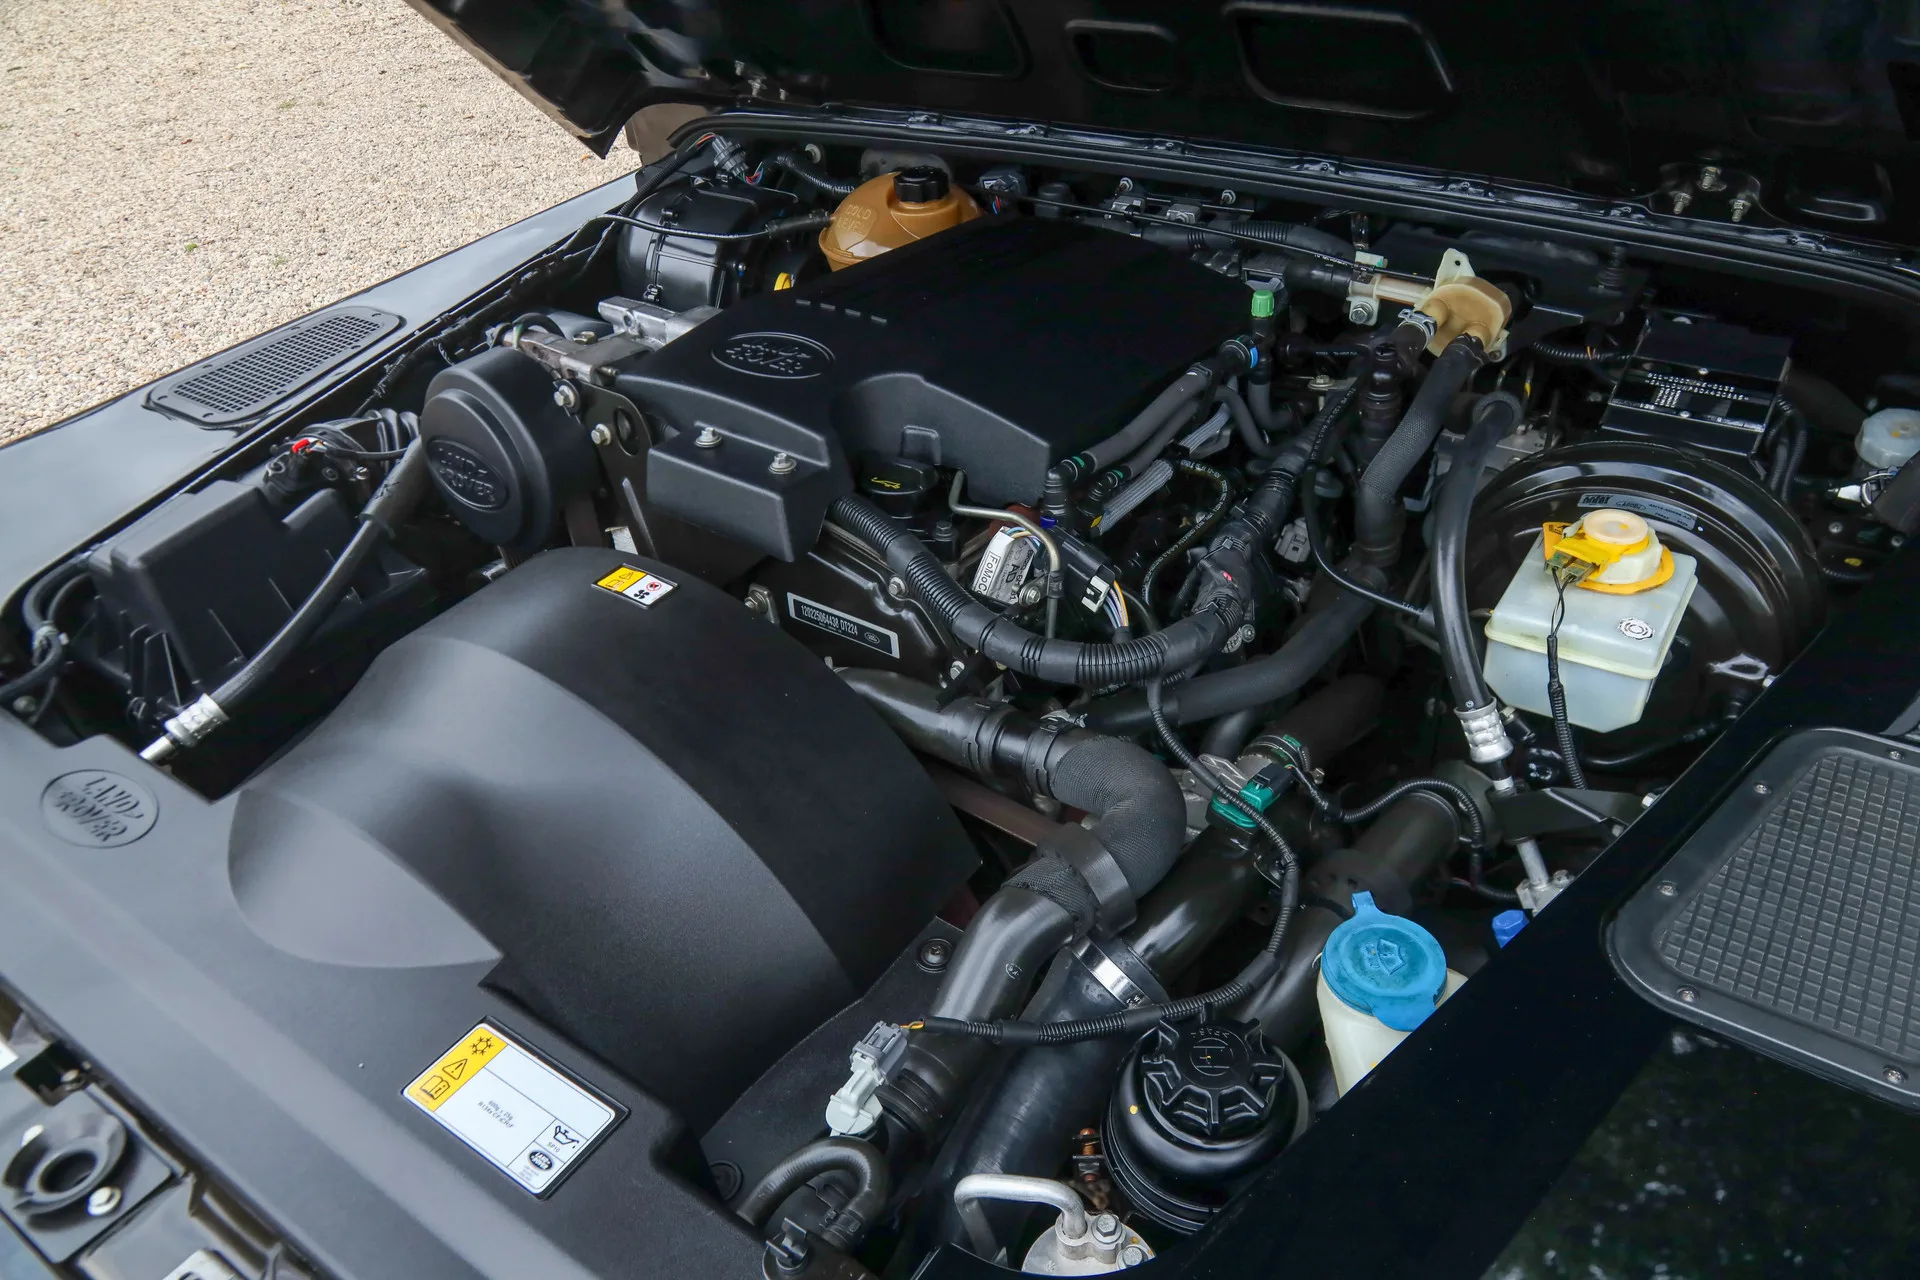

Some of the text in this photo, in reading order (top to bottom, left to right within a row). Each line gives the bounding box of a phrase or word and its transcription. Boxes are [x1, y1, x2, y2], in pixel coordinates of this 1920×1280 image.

[846, 204, 872, 220] COLD
[1006, 563, 1020, 584] AD
[82, 776, 141, 815] LAND
[55, 792, 128, 842] ROVER
